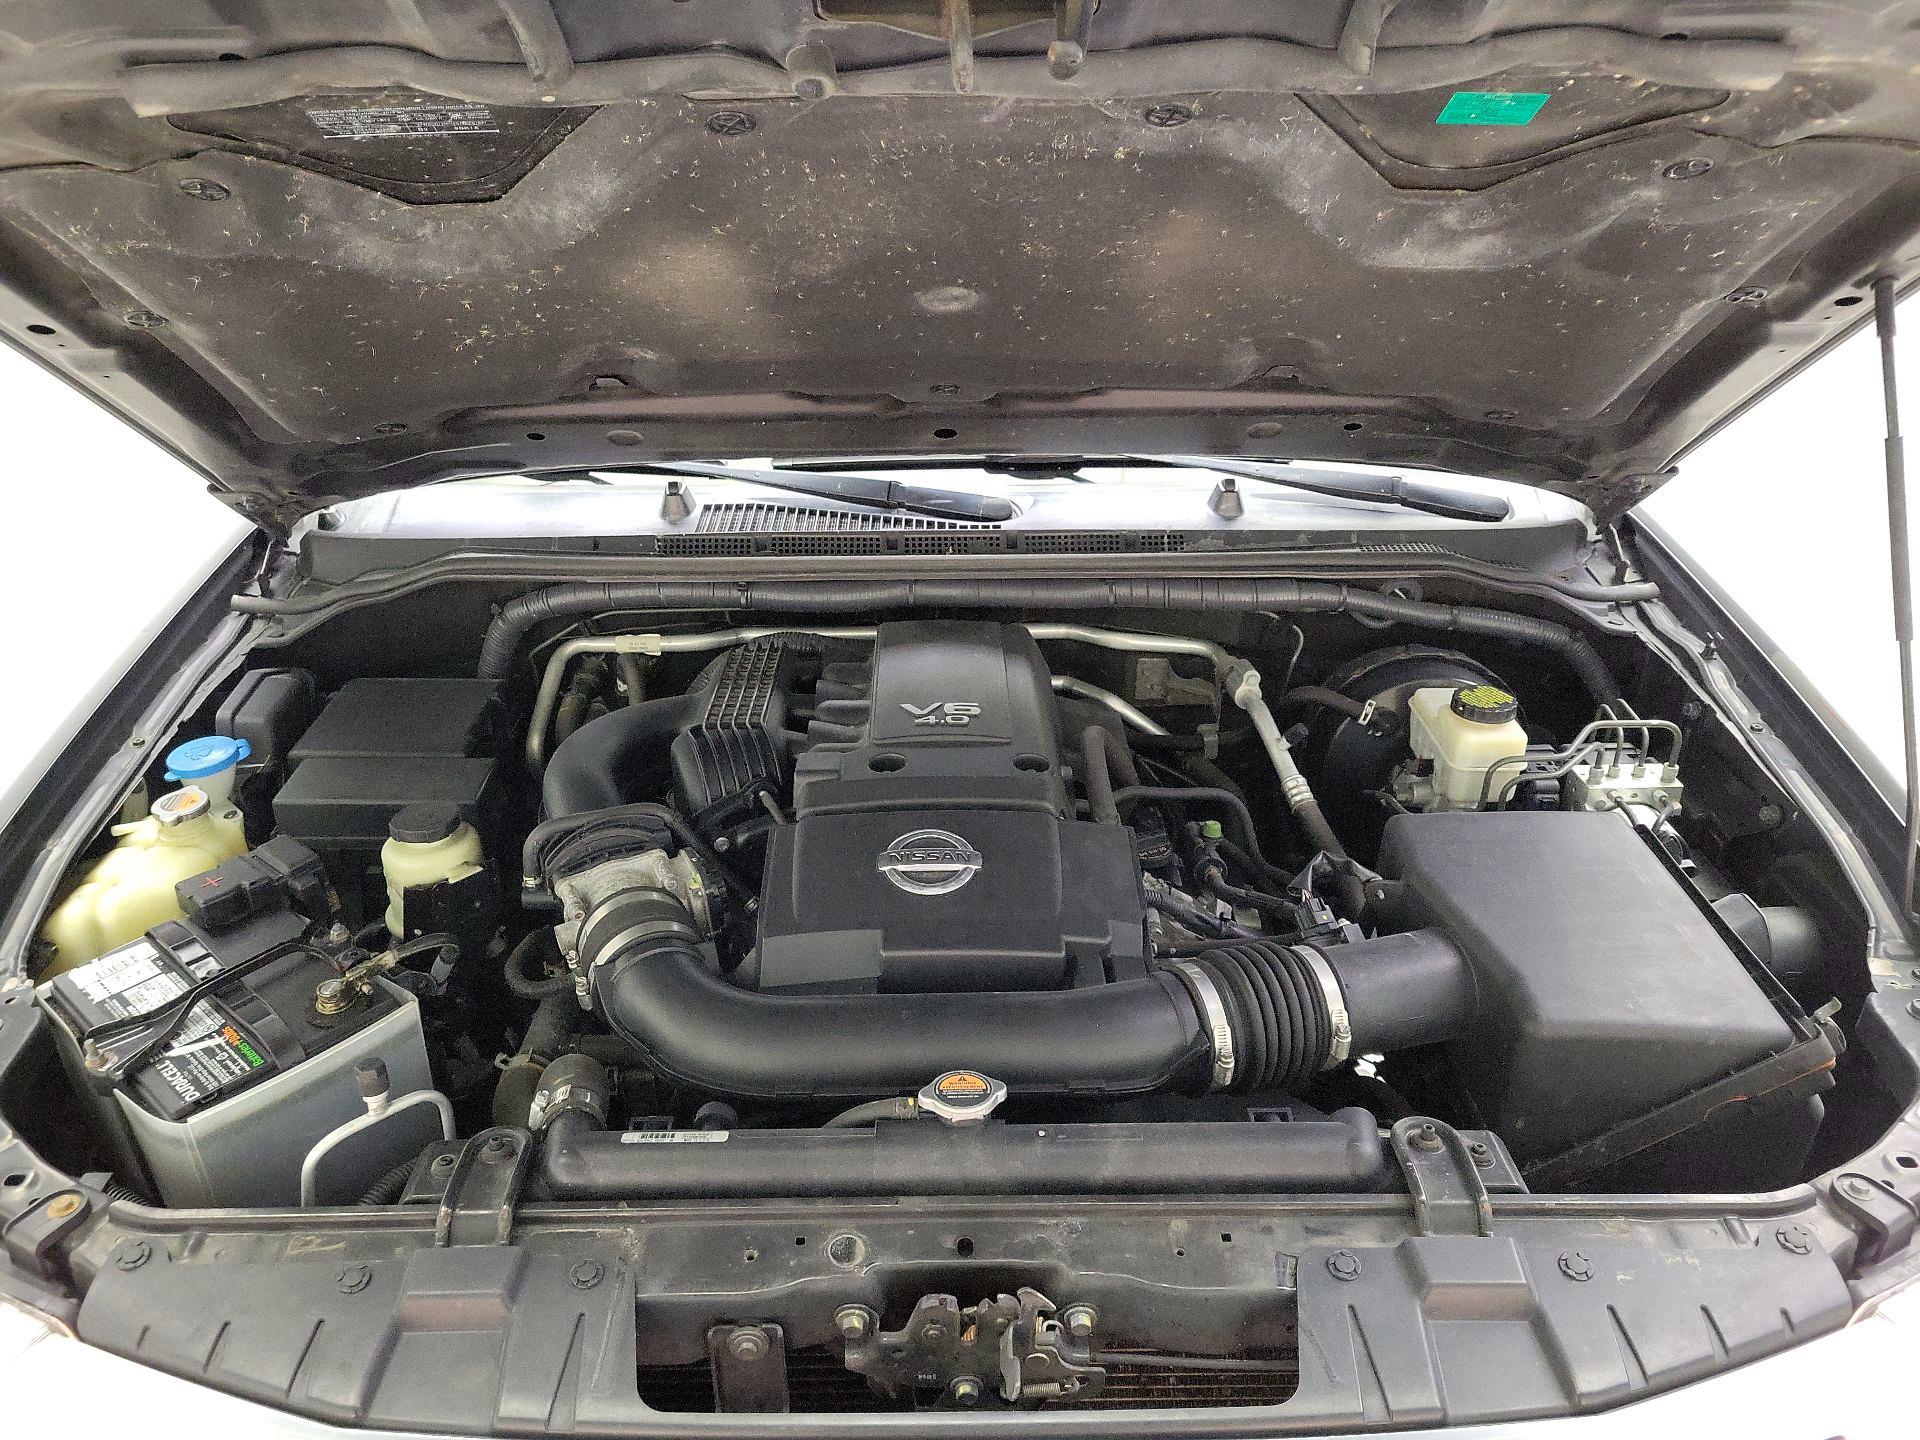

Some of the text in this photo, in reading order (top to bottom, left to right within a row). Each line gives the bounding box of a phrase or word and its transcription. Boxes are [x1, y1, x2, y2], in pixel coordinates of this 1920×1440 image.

[914, 715, 970, 726] 4.0
[889, 851, 971, 862] NISSAN
[156, 1060, 201, 1102] DURACELL
